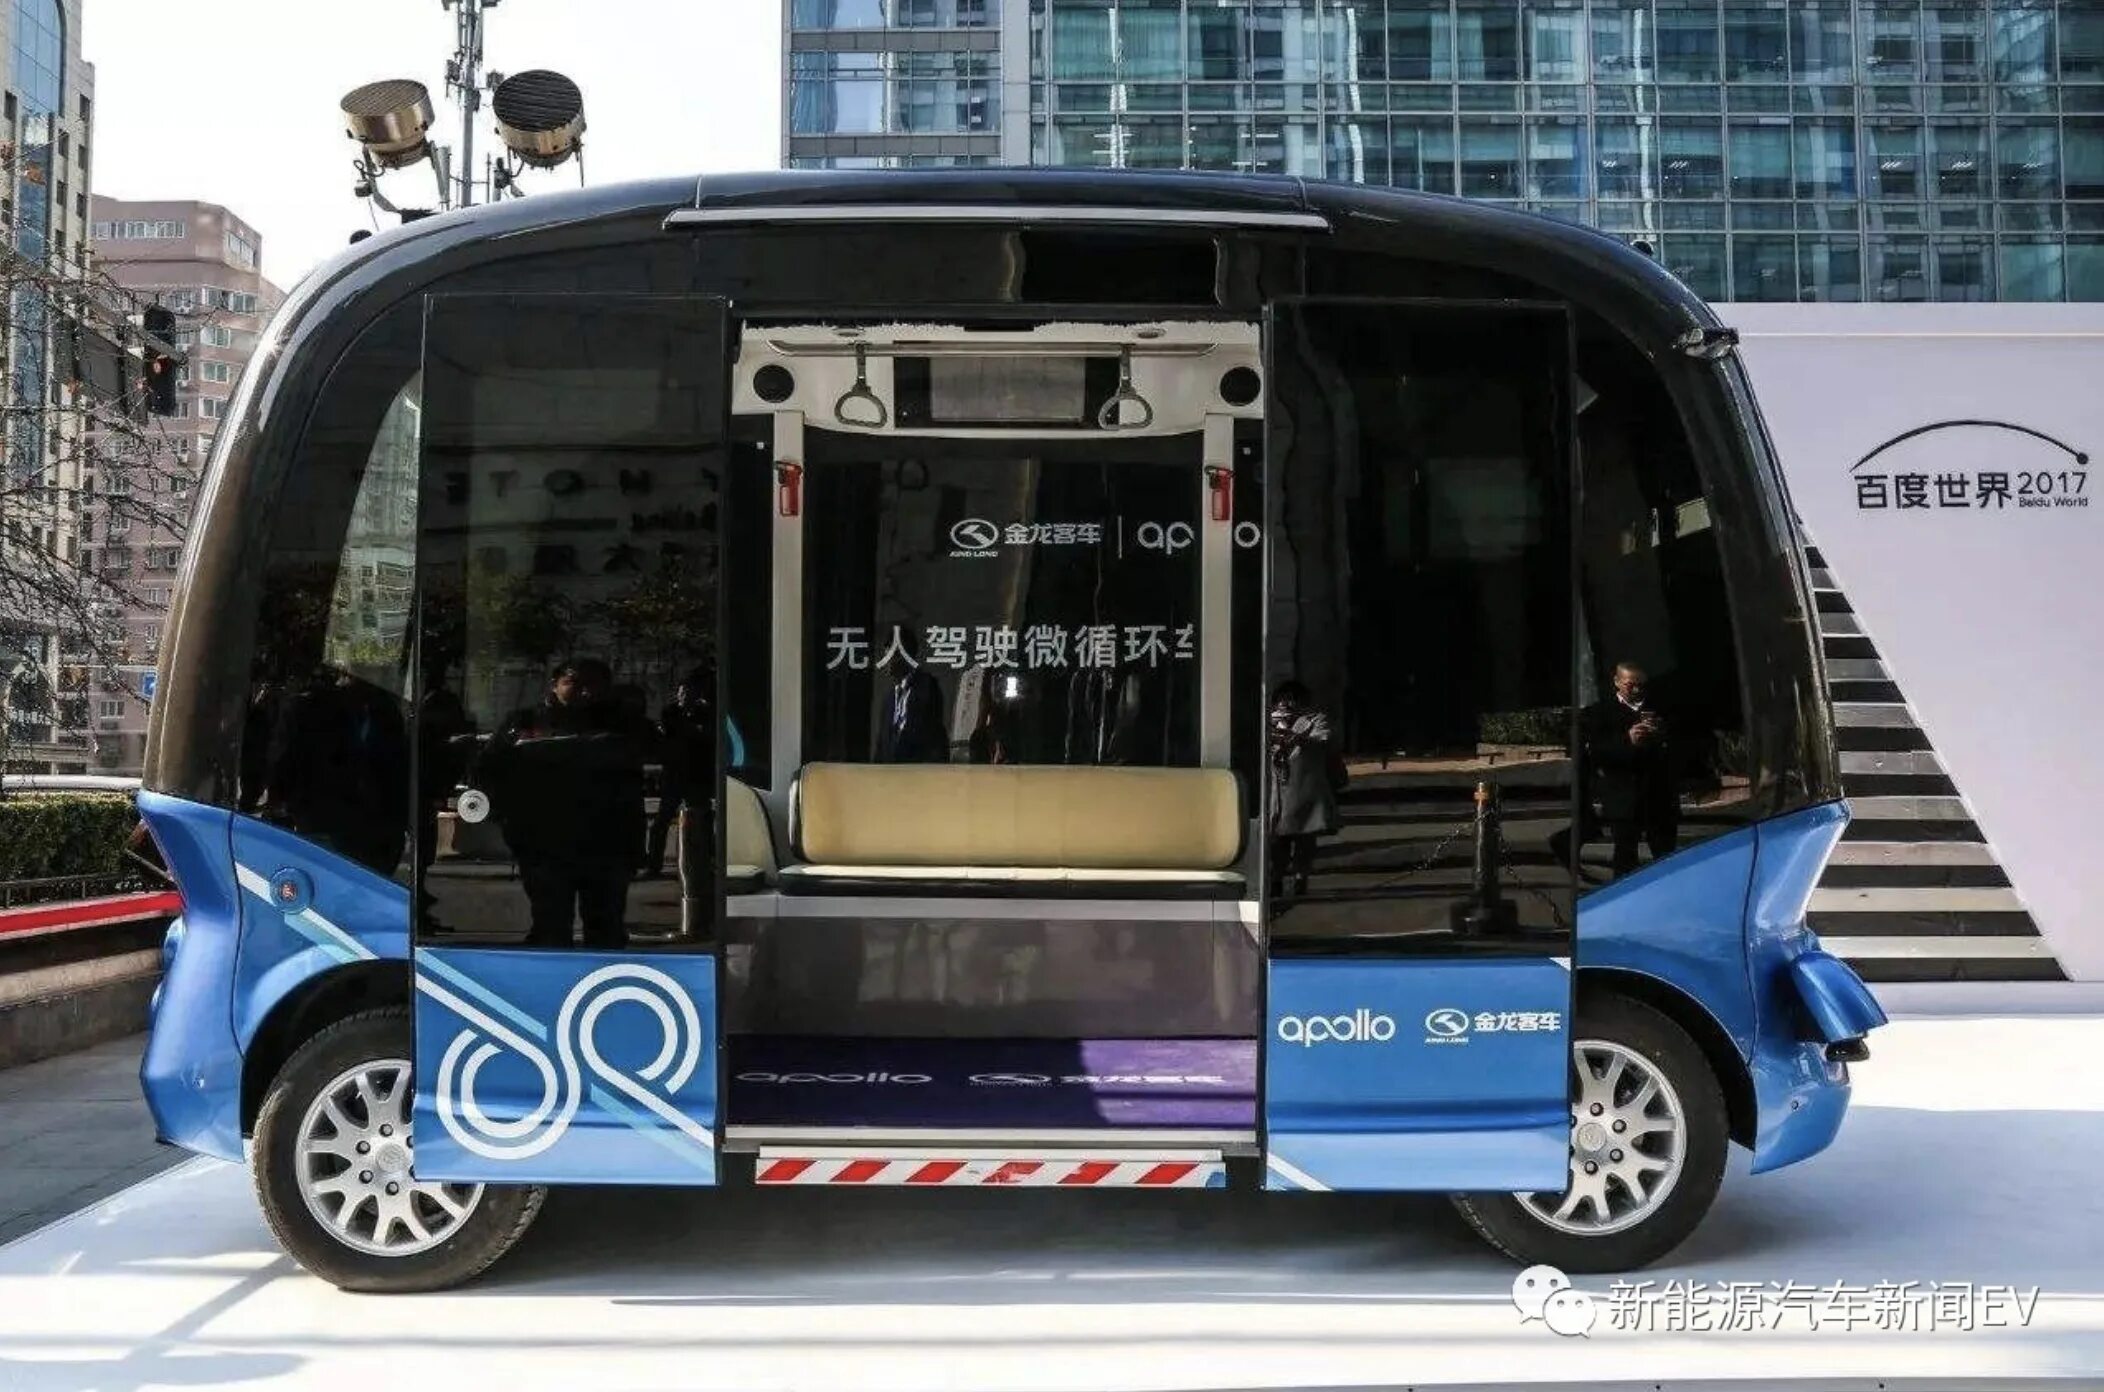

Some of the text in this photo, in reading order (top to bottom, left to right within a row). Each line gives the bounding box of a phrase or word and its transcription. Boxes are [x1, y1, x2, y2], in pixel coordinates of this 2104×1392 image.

[1853, 471, 2088, 509] 百度世界 2017
[2054, 497, 2088, 508] World
[1004, 521, 1261, 555] 金龙客车 apo
[1277, 1008, 1396, 1047] apollo
[1473, 1011, 1562, 1032] 金龙客车
[736, 1072, 933, 1084] apollo
